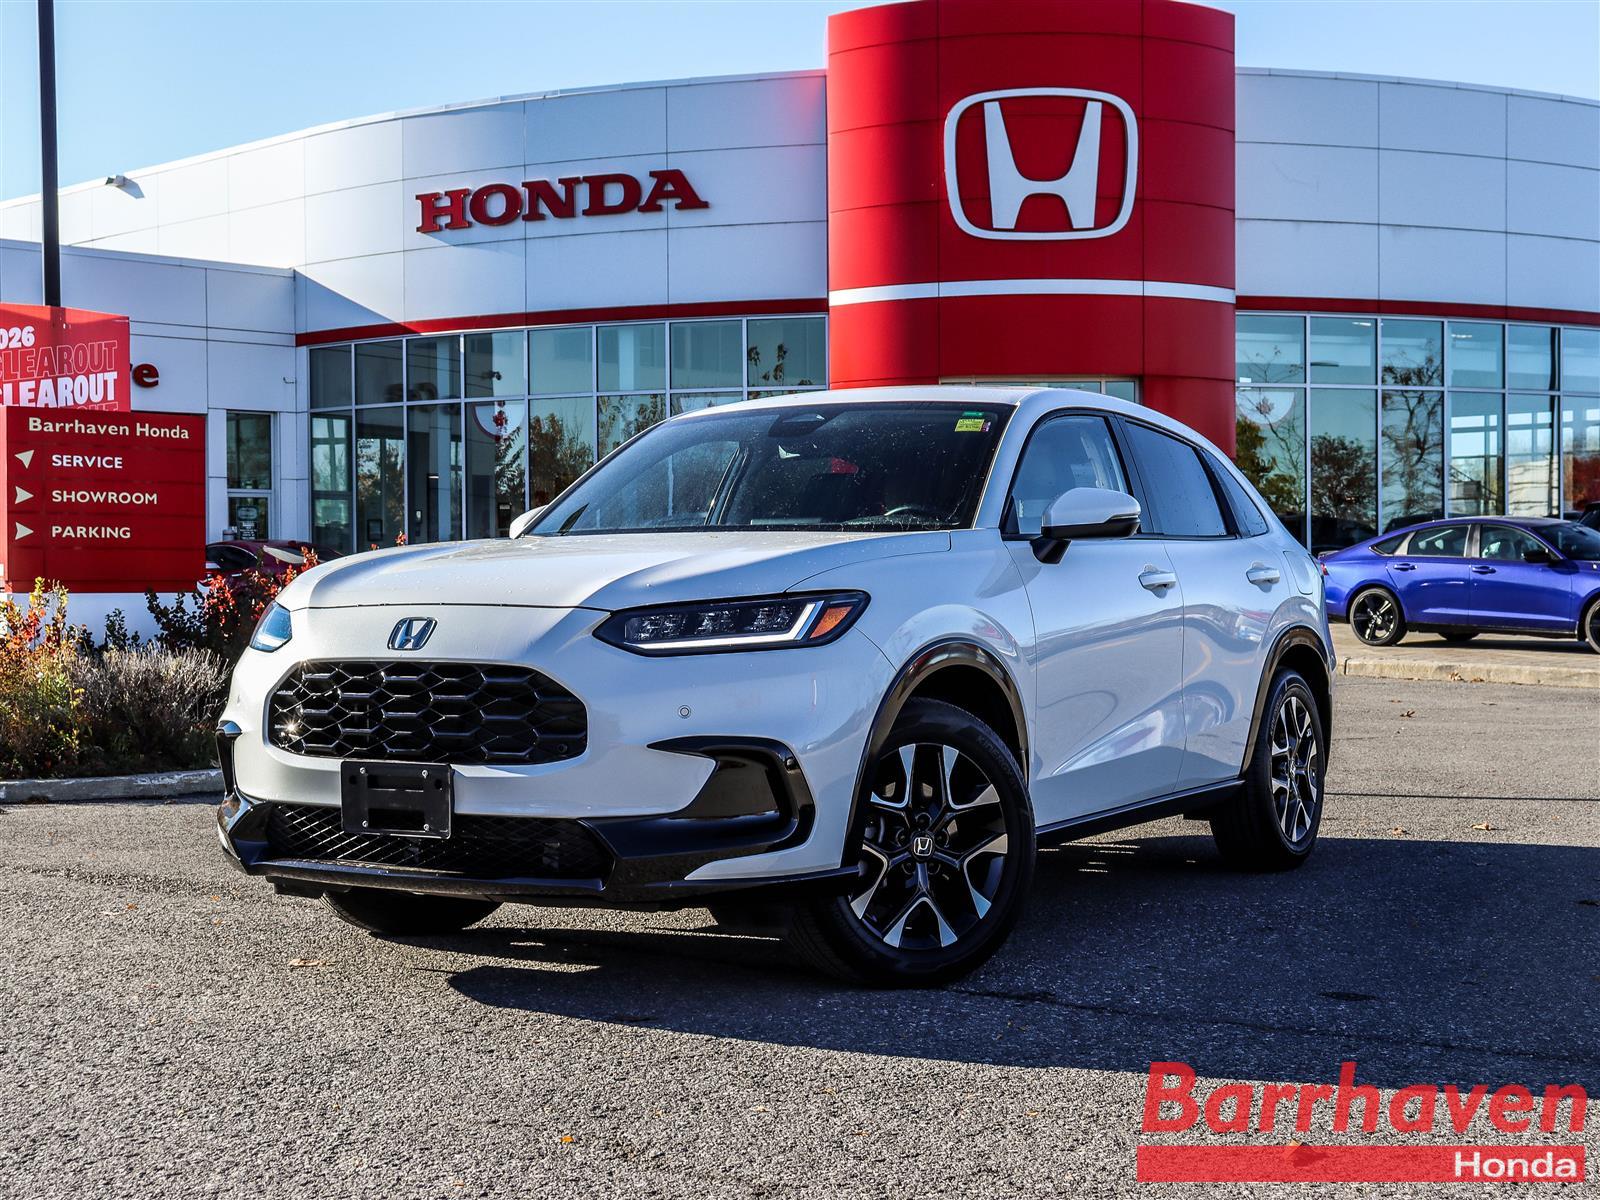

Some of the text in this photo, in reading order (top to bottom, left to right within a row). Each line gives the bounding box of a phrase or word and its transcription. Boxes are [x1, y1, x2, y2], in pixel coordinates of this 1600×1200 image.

[416, 169, 709, 233] HONDA
[0, 340, 117, 382] LEAROUT
[0, 371, 117, 408] LEAROUT
[28, 417, 190, 439] Barrhaven Honda
[52, 454, 123, 469] SERVICE
[52, 490, 158, 505] SHOWROOM
[52, 525, 131, 539] PARKING
